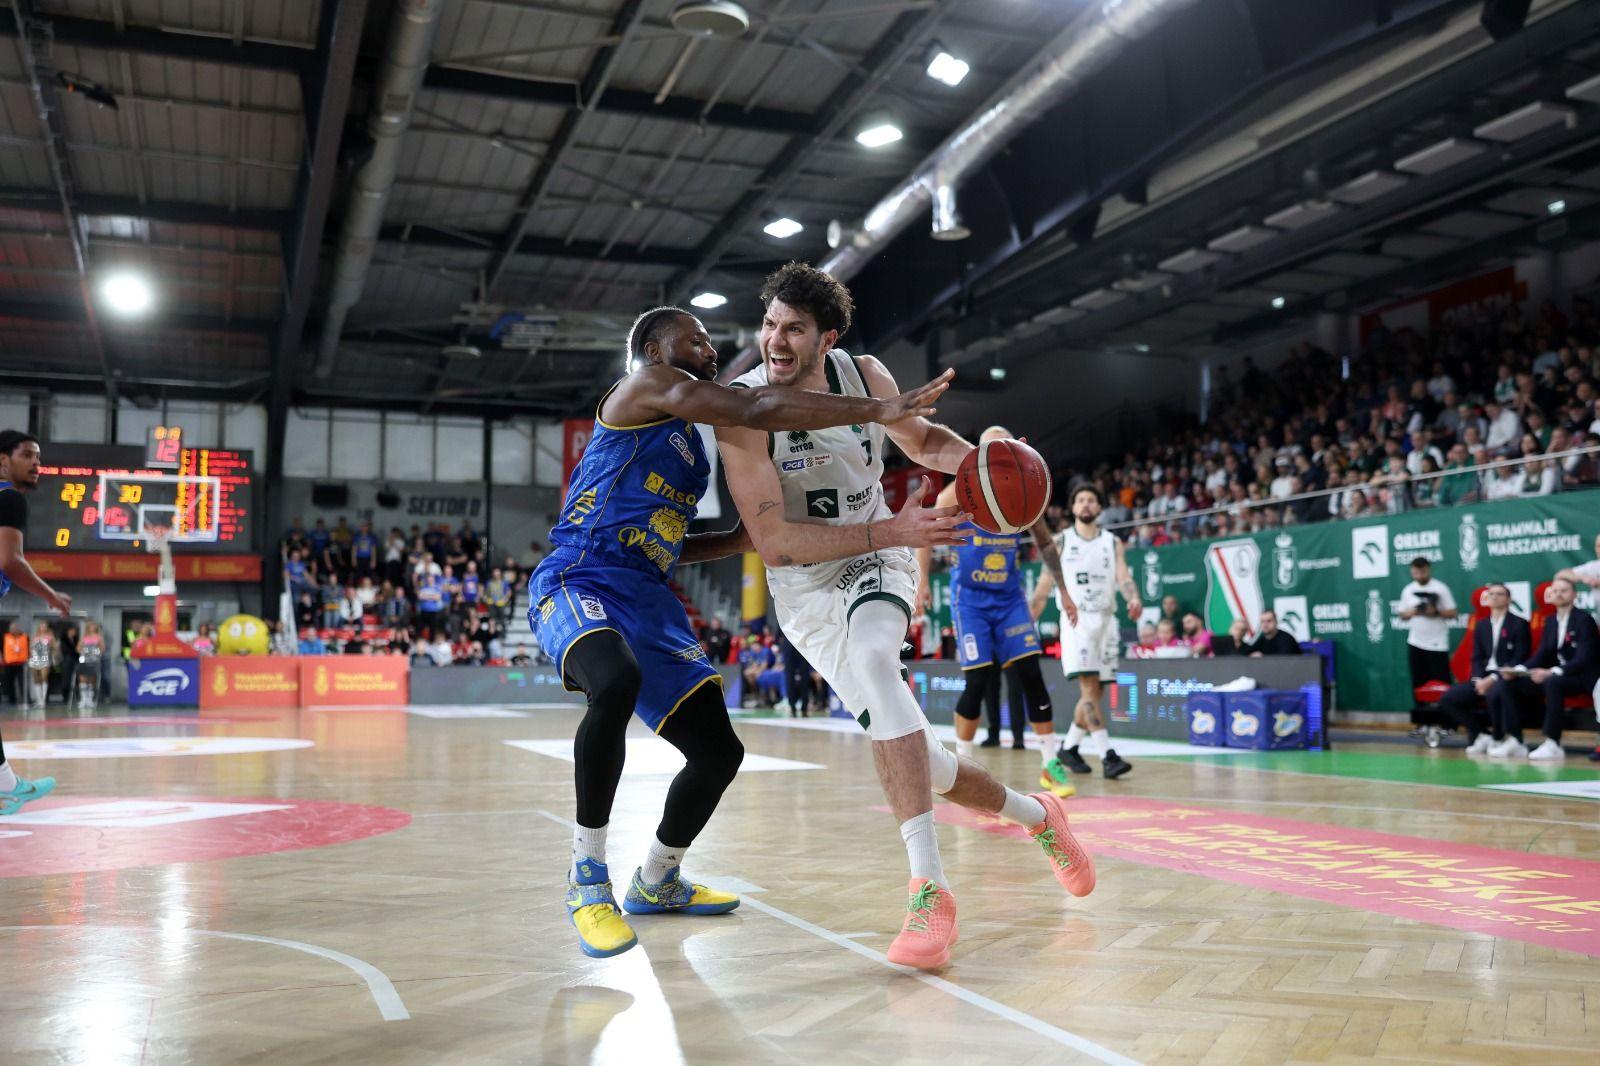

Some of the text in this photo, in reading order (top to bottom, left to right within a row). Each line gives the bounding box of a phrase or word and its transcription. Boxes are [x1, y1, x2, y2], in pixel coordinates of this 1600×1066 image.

[156, 440, 180, 462] 12
[790, 441, 814, 454] errea
[785, 461, 803, 470] PGE
[119, 485, 143, 503] 30
[660, 483, 697, 506] TASO
[1486, 519, 1558, 539] TRAMWAJE
[1393, 530, 1441, 550] ORLEN
[1487, 535, 1582, 557] WARSZAWSKIE
[836, 557, 872, 591] UNIQA
[1312, 603, 1350, 619] ORLEN
[137, 680, 178, 695] PGE
[1188, 823, 1574, 882] TRAMWAJE
[1112, 827, 1600, 914] WARSZAWSKIE
[1383, 896, 1593, 934] miastu
